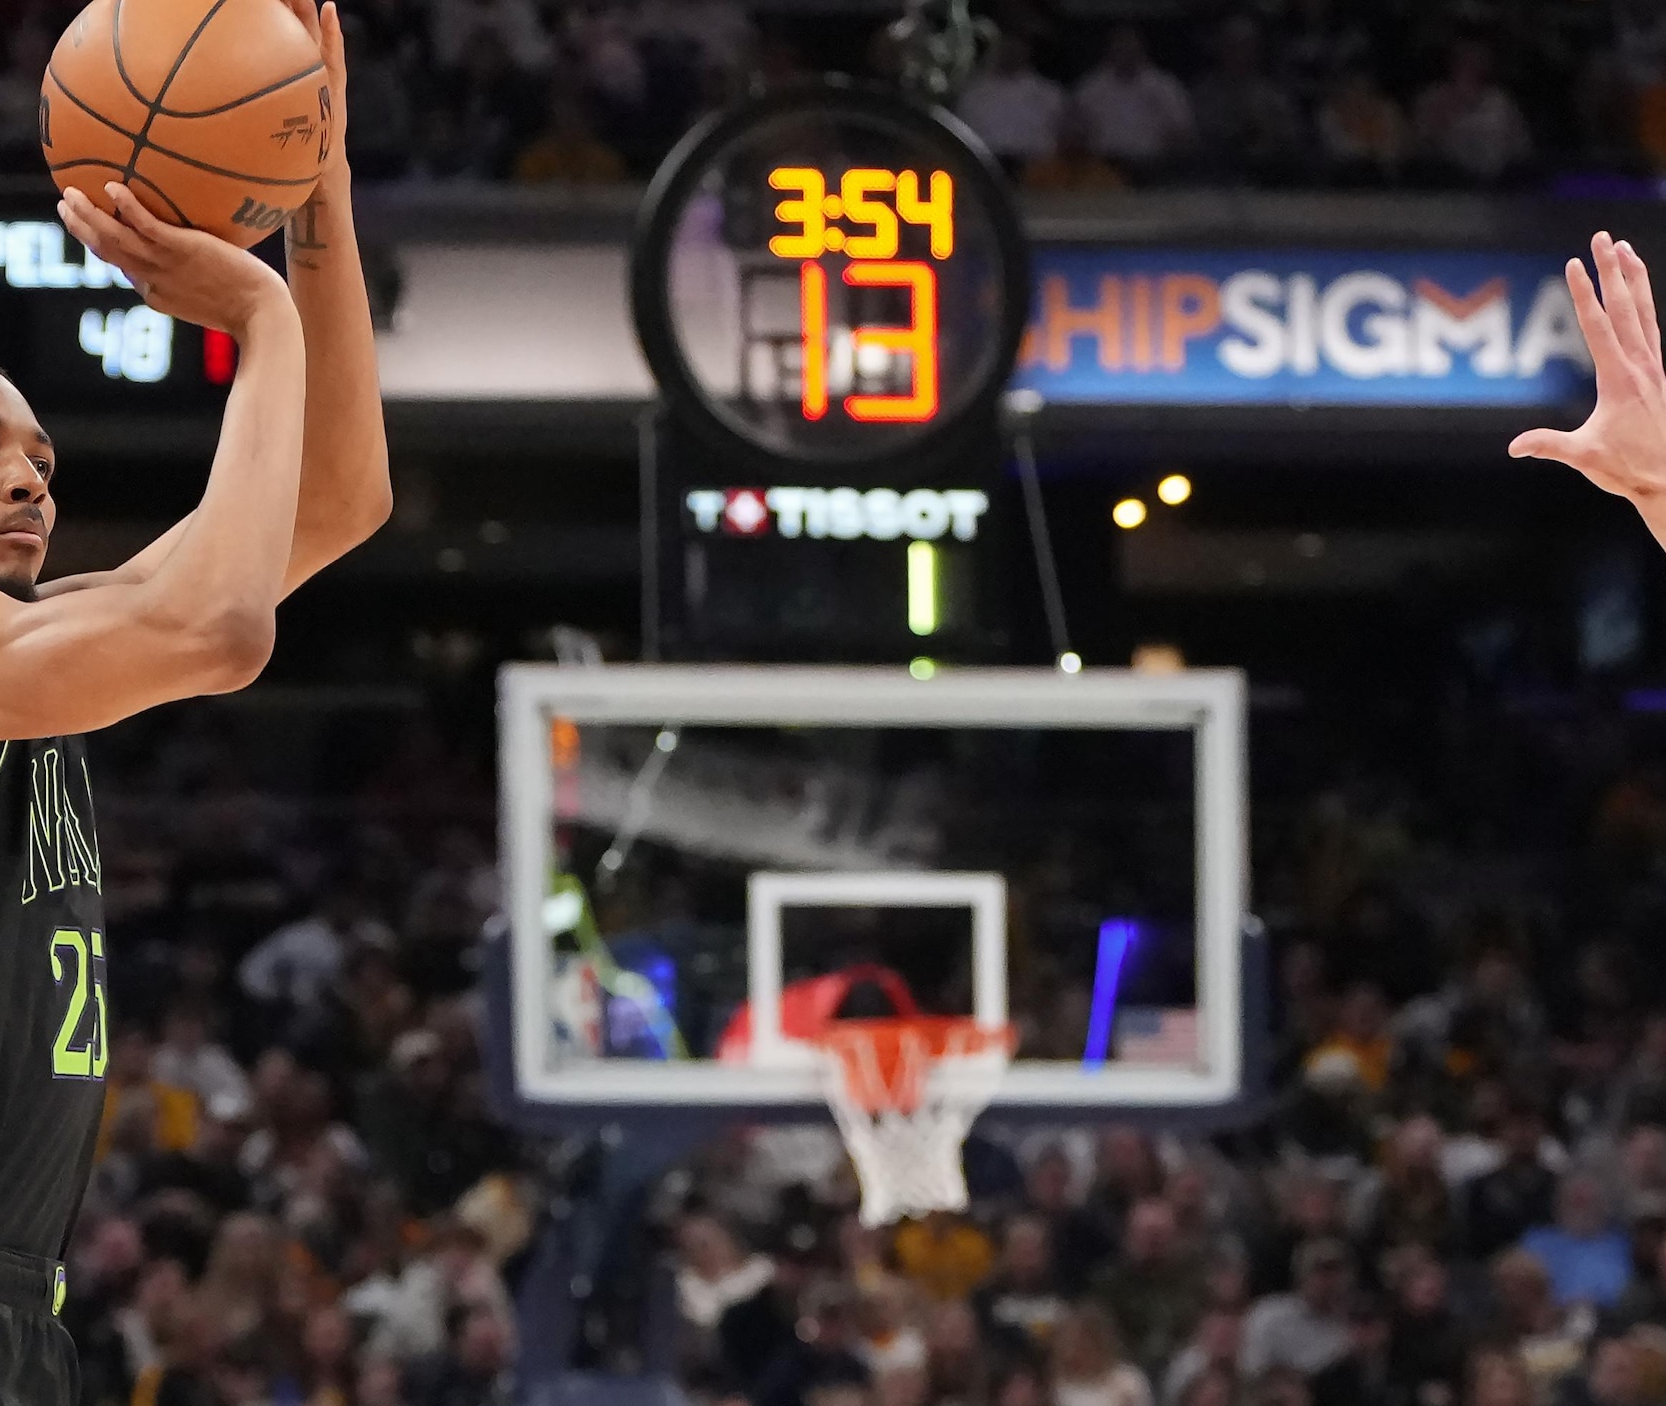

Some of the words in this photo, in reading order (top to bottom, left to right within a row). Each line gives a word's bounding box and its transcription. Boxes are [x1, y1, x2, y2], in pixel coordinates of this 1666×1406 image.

[768, 167, 954, 260] 3:54
[78, 304, 174, 383] 48
[801, 260, 938, 423] 13
[1019, 268, 1593, 380] HIPSIGMA
[766, 486, 989, 541] TISSOT
